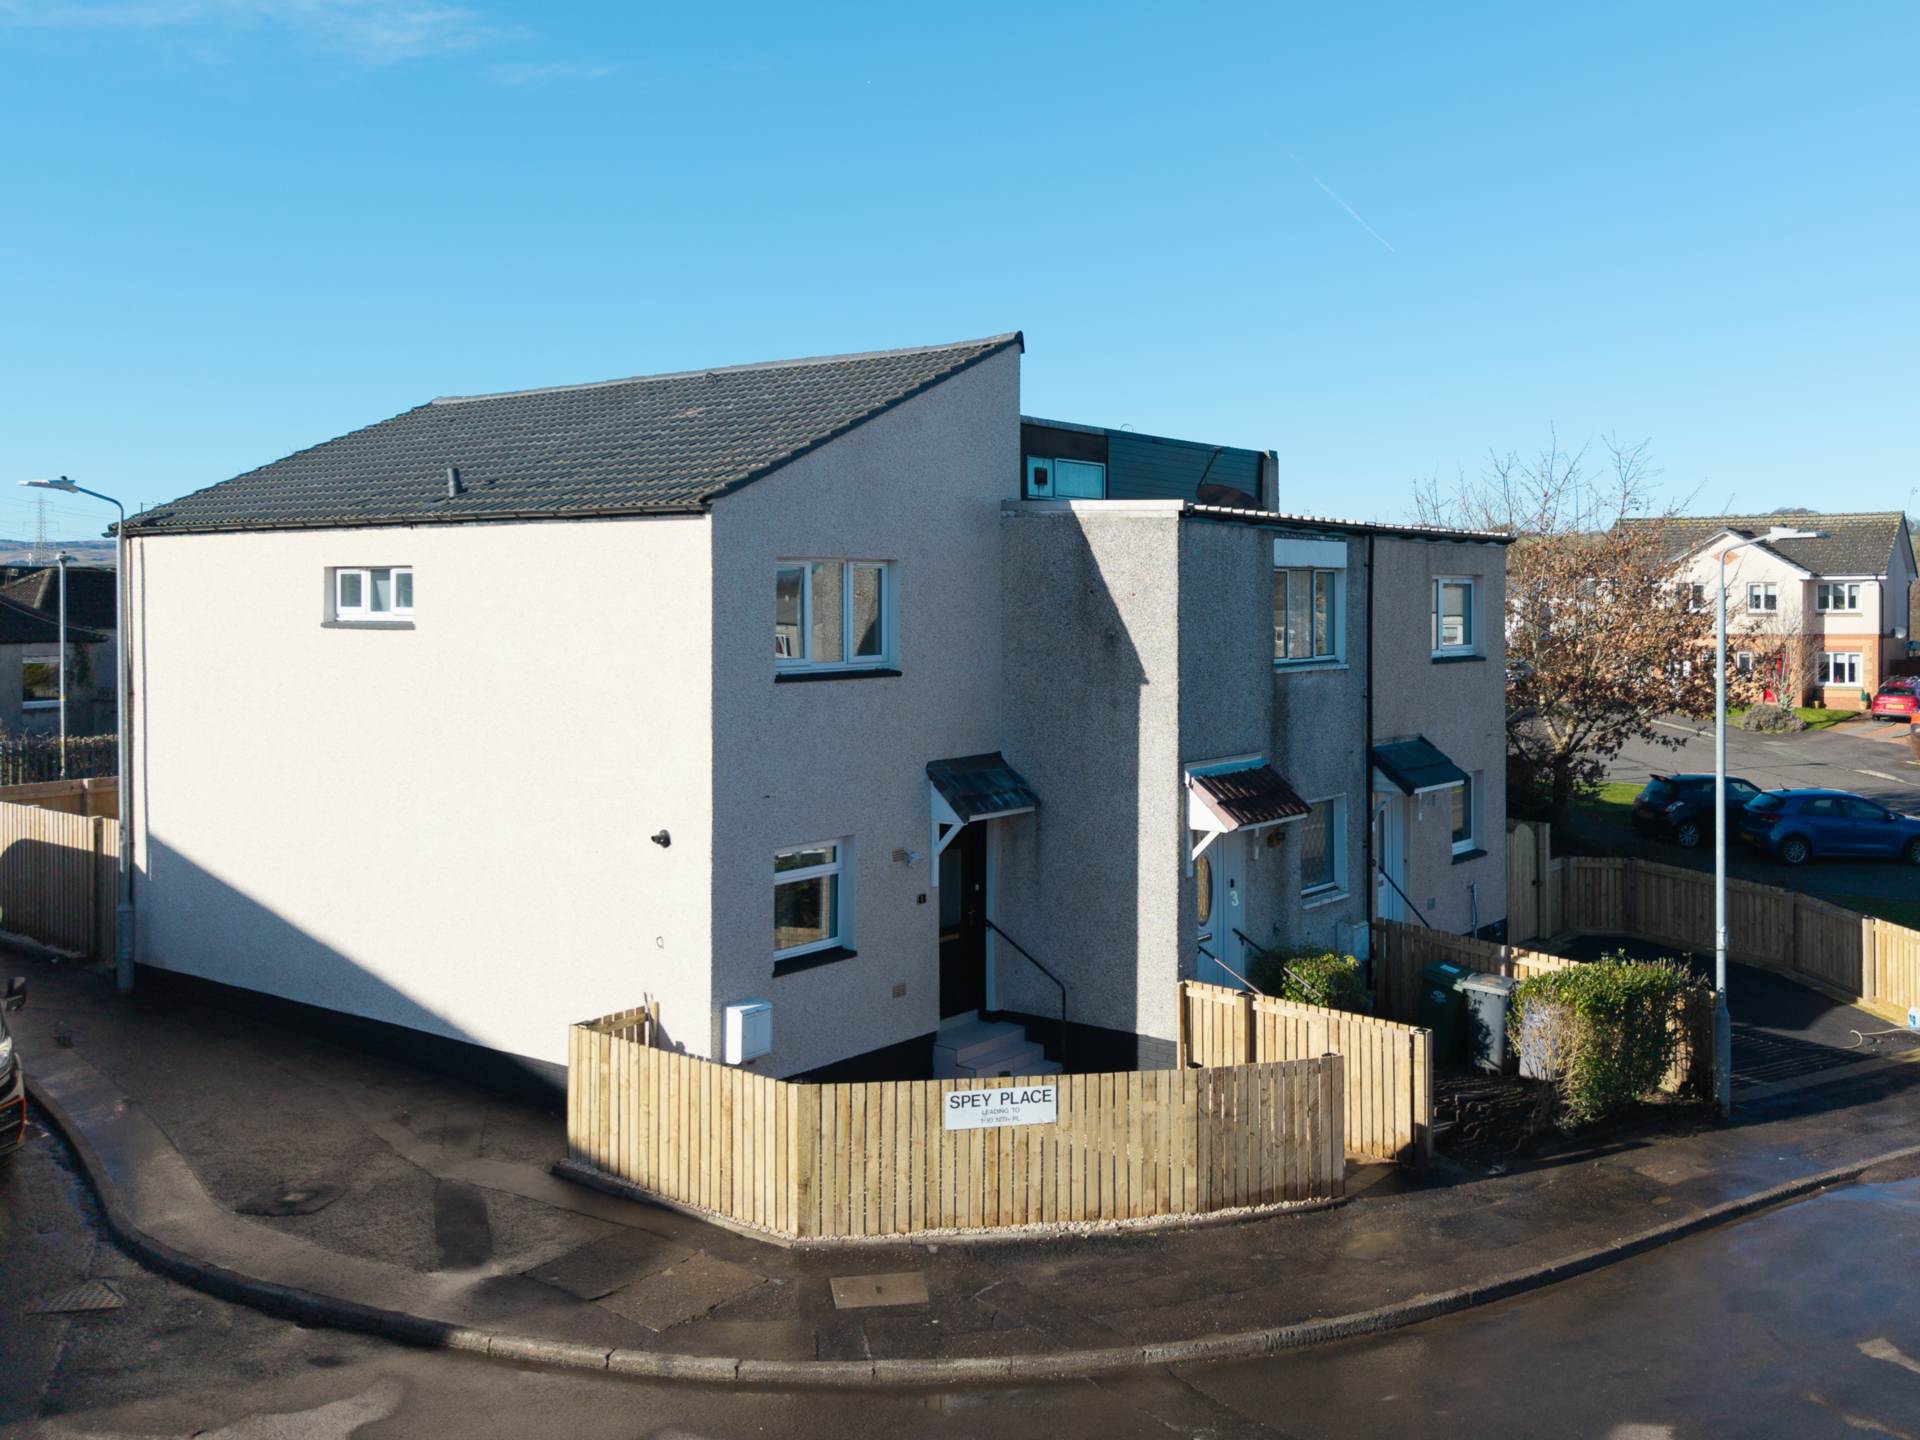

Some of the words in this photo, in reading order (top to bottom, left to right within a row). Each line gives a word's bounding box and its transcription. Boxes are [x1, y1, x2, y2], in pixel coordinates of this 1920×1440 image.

[1230, 890, 1239, 906] 3
[950, 1093, 992, 1109] SPEY
[1000, 1089, 1052, 1105] PLACE
